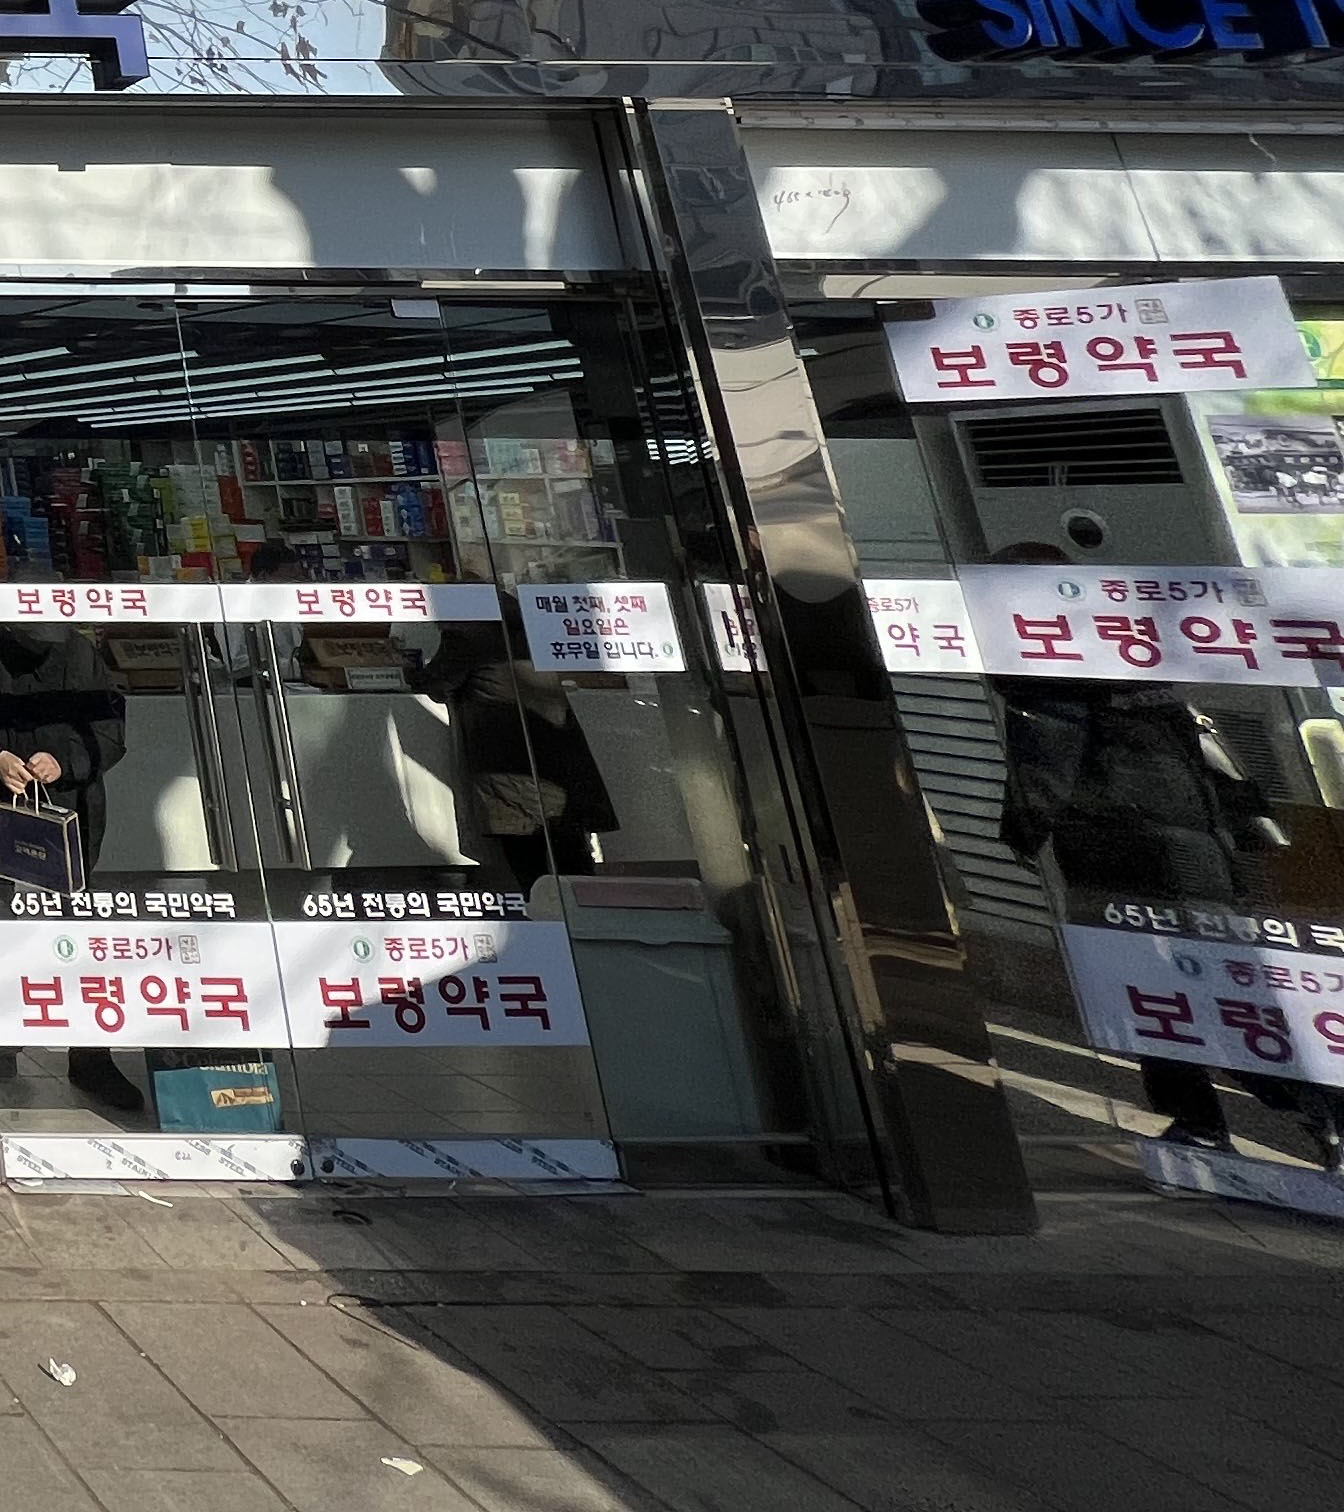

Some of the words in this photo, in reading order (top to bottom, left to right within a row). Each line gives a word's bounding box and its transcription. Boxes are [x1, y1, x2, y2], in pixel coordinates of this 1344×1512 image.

[1013, 303, 1128, 328] 종로5가
[931, 331, 1248, 390] 보령약국
[17, 589, 149, 617] 보령약국
[296, 589, 428, 617] 보령약국
[536, 595, 568, 614] 매월
[613, 595, 648, 614] 셋째
[1102, 579, 1223, 605] 종로5가
[562, 617, 630, 637] 일요일은
[550, 641, 600, 661] 휴무일
[604, 641, 660, 661] 입니다.
[1014, 613, 1344, 670] 보령약국
[10, 892, 64, 917] 65년
[144, 892, 237, 918] 국민약국
[302, 892, 356, 918] 65년
[436, 893, 528, 919] 국민약국
[1104, 902, 1181, 933] 65년
[88, 937, 172, 961] 종로5가
[384, 936, 469, 961] 종로5가
[21, 975, 250, 1033] 보령약국
[319, 975, 552, 1032] 보령약국
